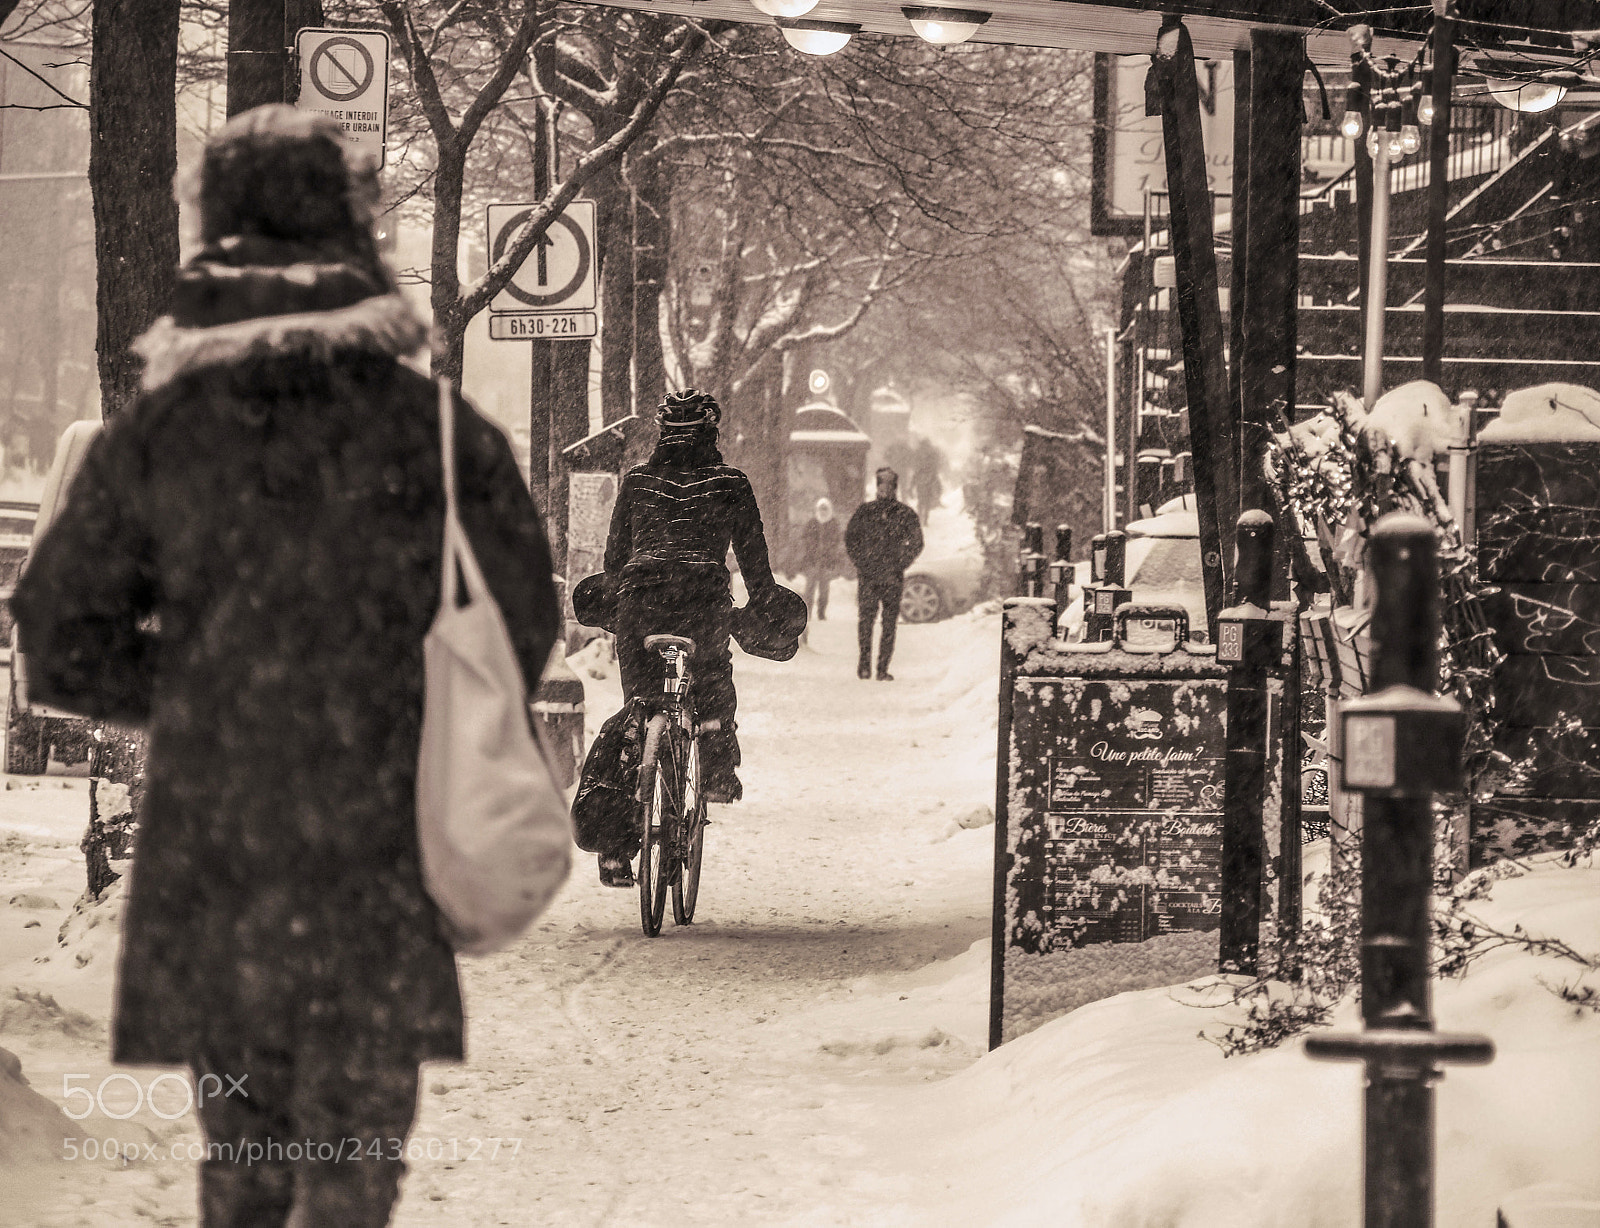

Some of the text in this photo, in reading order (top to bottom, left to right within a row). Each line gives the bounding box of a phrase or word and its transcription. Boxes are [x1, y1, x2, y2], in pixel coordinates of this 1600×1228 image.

[345, 110, 378, 121] INTERDIT
[353, 122, 380, 132] URBAIN
[511, 318, 577, 335] 6h30-22h
[1223, 625, 1237, 642] PG
[1090, 740, 1204, 767] Une petite faim?
